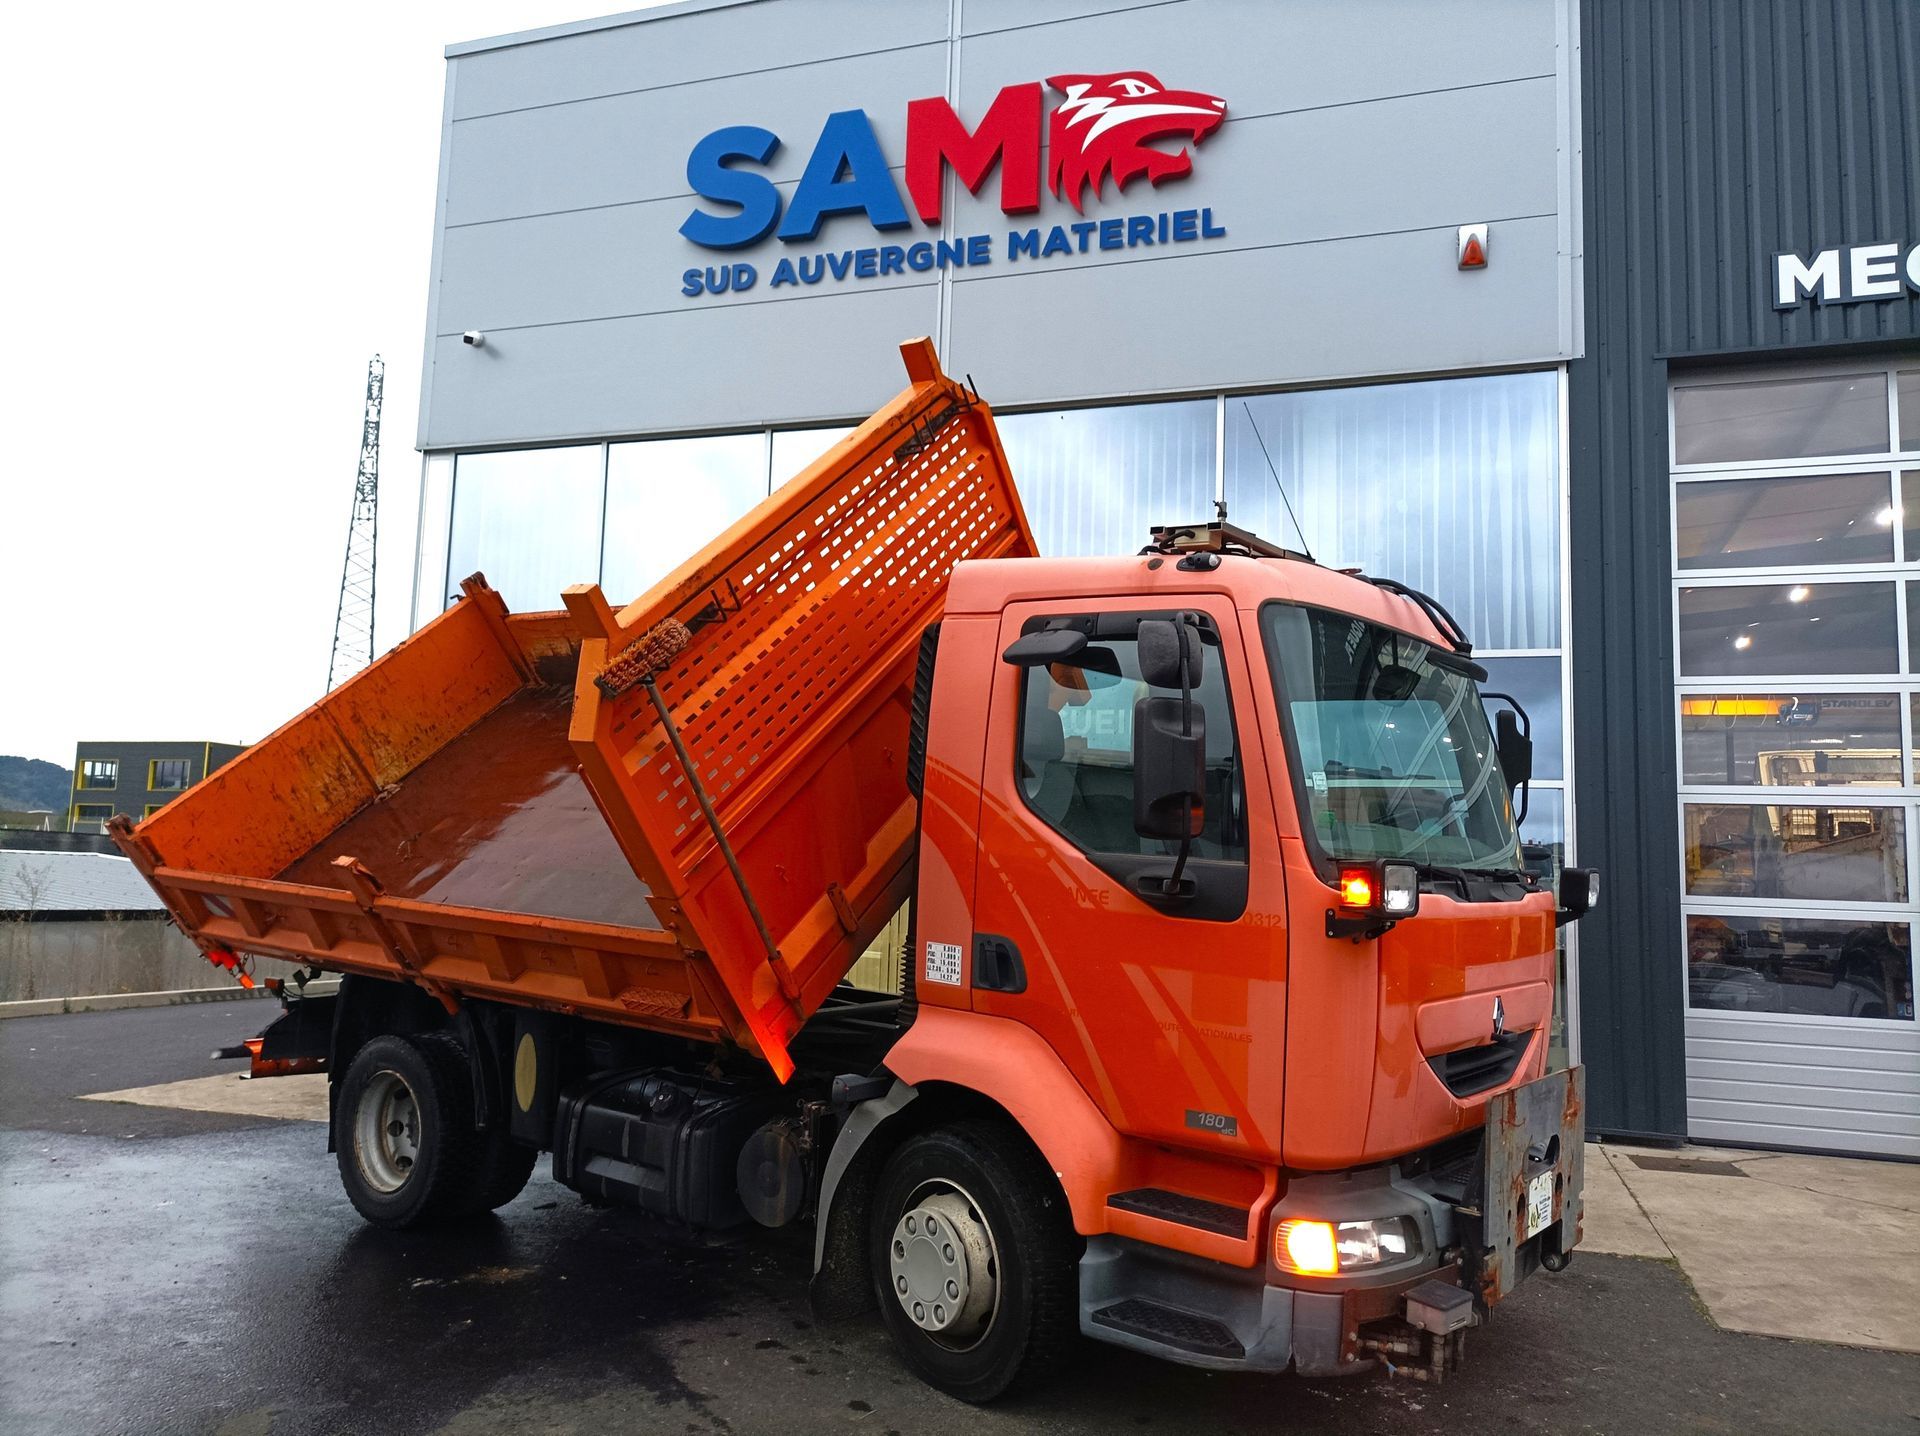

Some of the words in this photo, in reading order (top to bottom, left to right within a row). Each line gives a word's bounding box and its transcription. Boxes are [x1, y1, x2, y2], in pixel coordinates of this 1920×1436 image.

[679, 81, 1043, 251] SAM
[681, 262, 757, 297] SUD
[769, 235, 991, 287] AUVERGNE
[1006, 208, 1226, 260] MATERIEL
[1198, 1112, 1225, 1128] 180
